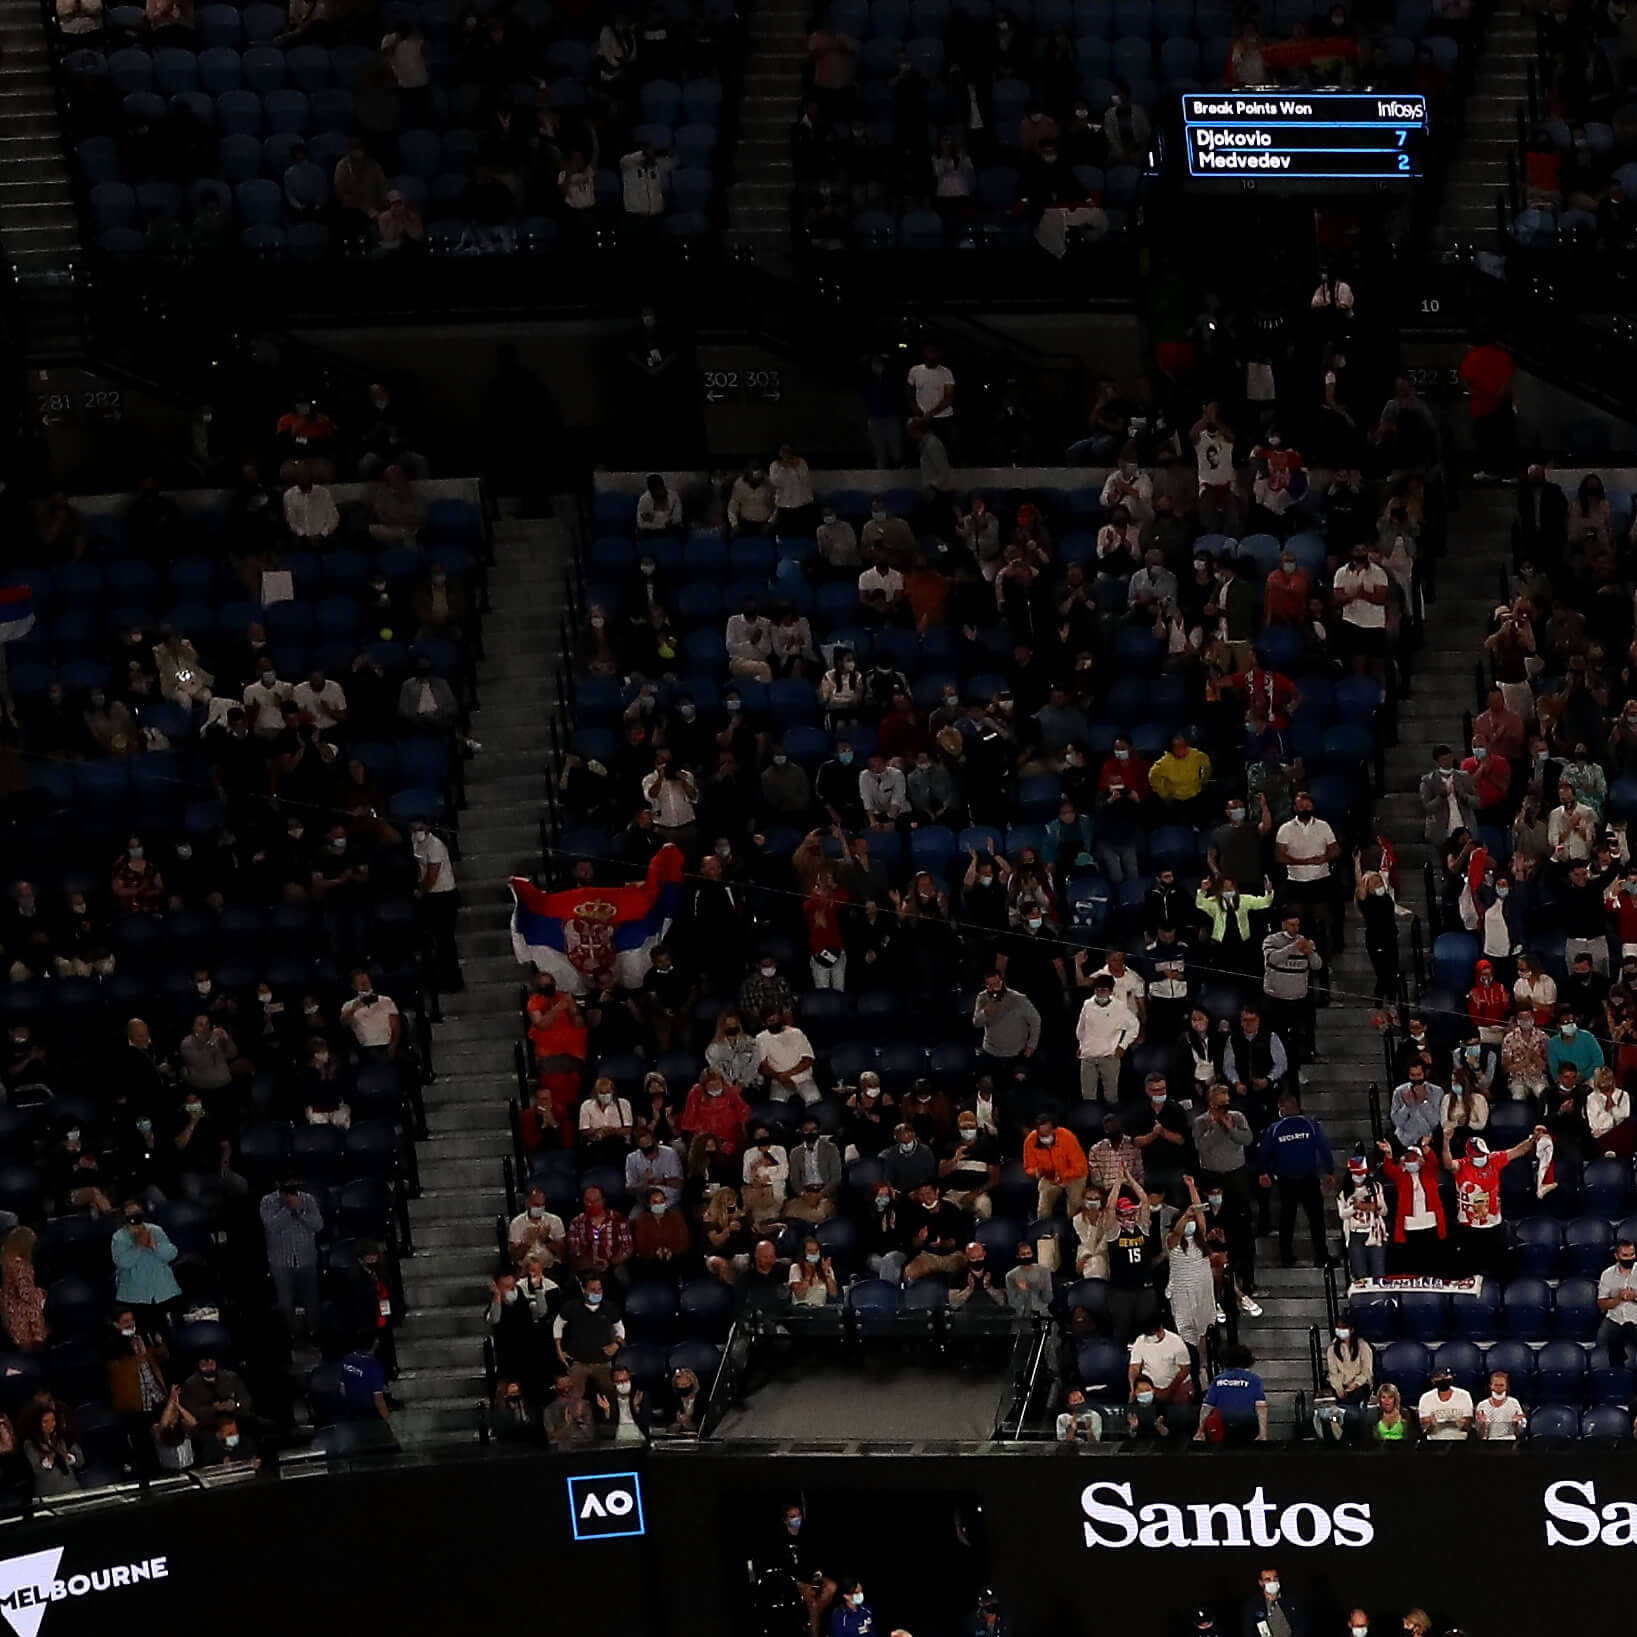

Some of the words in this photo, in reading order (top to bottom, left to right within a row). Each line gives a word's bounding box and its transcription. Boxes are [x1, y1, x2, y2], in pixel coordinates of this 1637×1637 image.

[1194, 102, 1233, 115] Break
[1237, 101, 1277, 115] Points
[1280, 102, 1312, 115] Won
[1378, 101, 1423, 118] Infosys
[1395, 131, 1407, 146] 7
[1199, 152, 1291, 168] Medvedev
[1398, 155, 1410, 170] 2
[1421, 299, 1440, 312] 10
[1128, 1248, 1141, 1264] 15
[579, 1489, 634, 1518] AO
[1081, 1481, 1375, 1548] Santos
